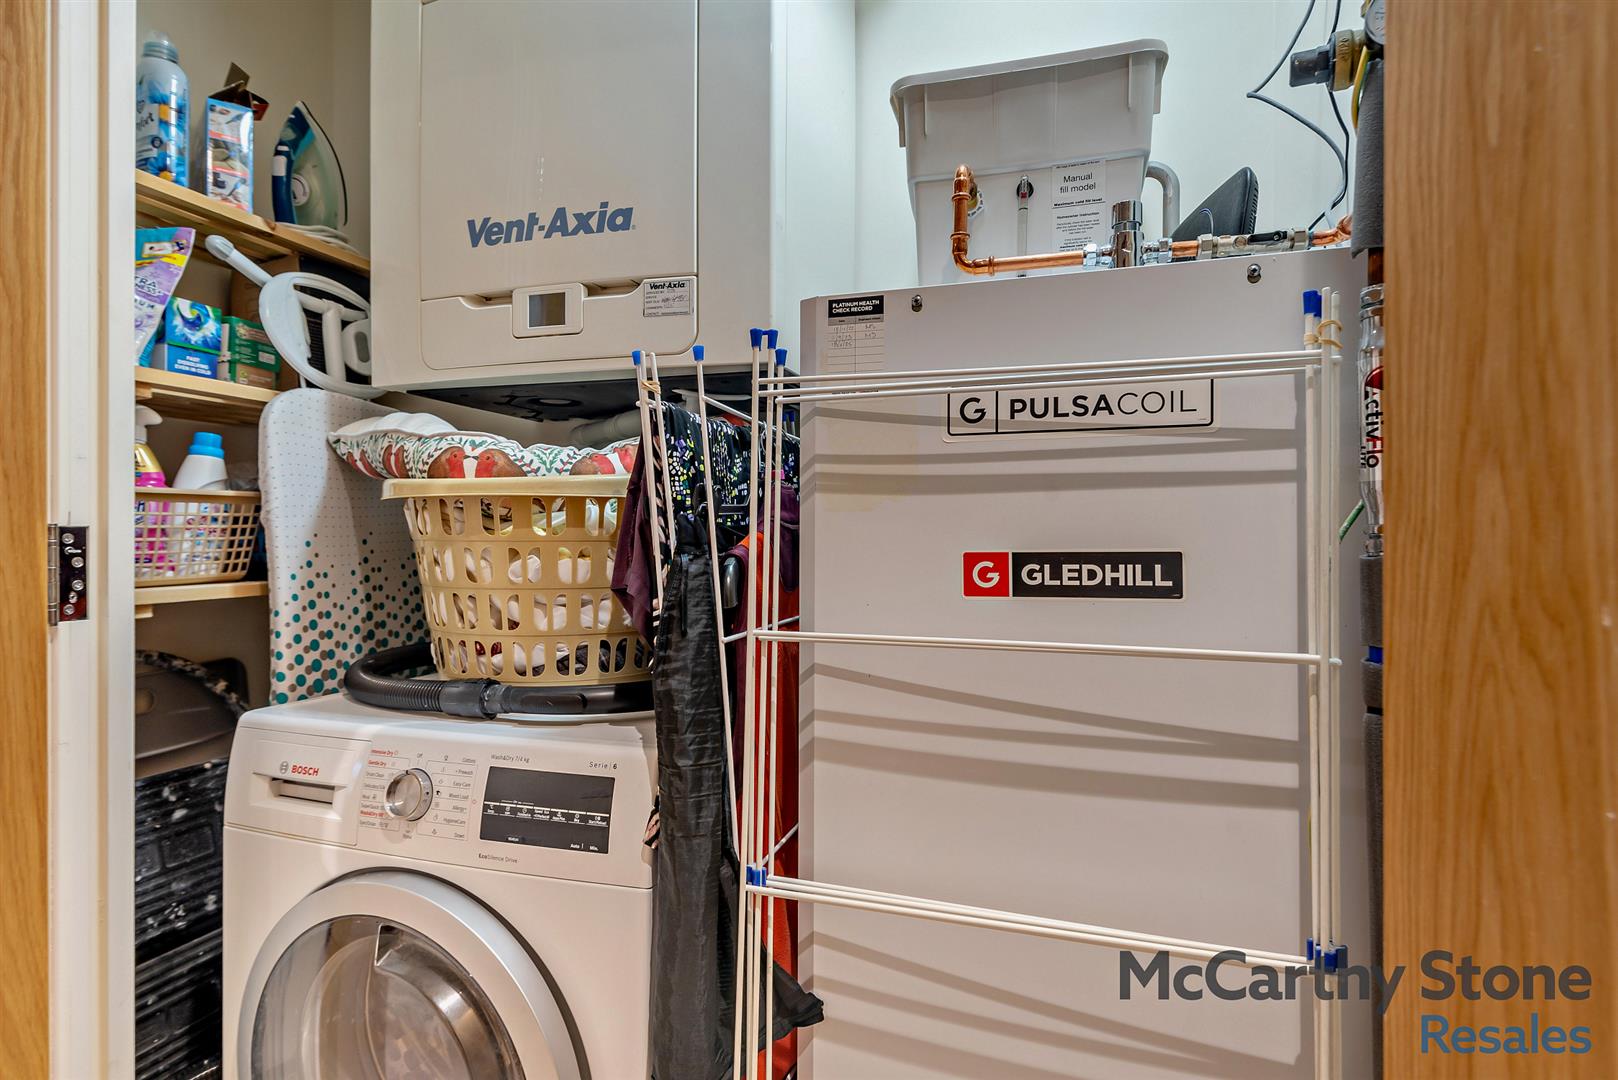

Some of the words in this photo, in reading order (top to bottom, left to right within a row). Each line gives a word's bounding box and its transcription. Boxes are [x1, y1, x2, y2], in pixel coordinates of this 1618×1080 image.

[1063, 172, 1092, 183] Manual
[1060, 185, 1069, 194] fill
[1070, 182, 1096, 192] model
[467, 201, 633, 248] Vent-Axia
[650, 281, 686, 290] Vent-Axia
[832, 301, 858, 309] PLATINUM
[959, 397, 987, 424] G
[1009, 390, 1197, 420] PULSACOIL
[972, 561, 1000, 588] G
[1021, 564, 1173, 586] GLEDHILL
[291, 764, 319, 776] BOSCH
[589, 761, 608, 769] Serie
